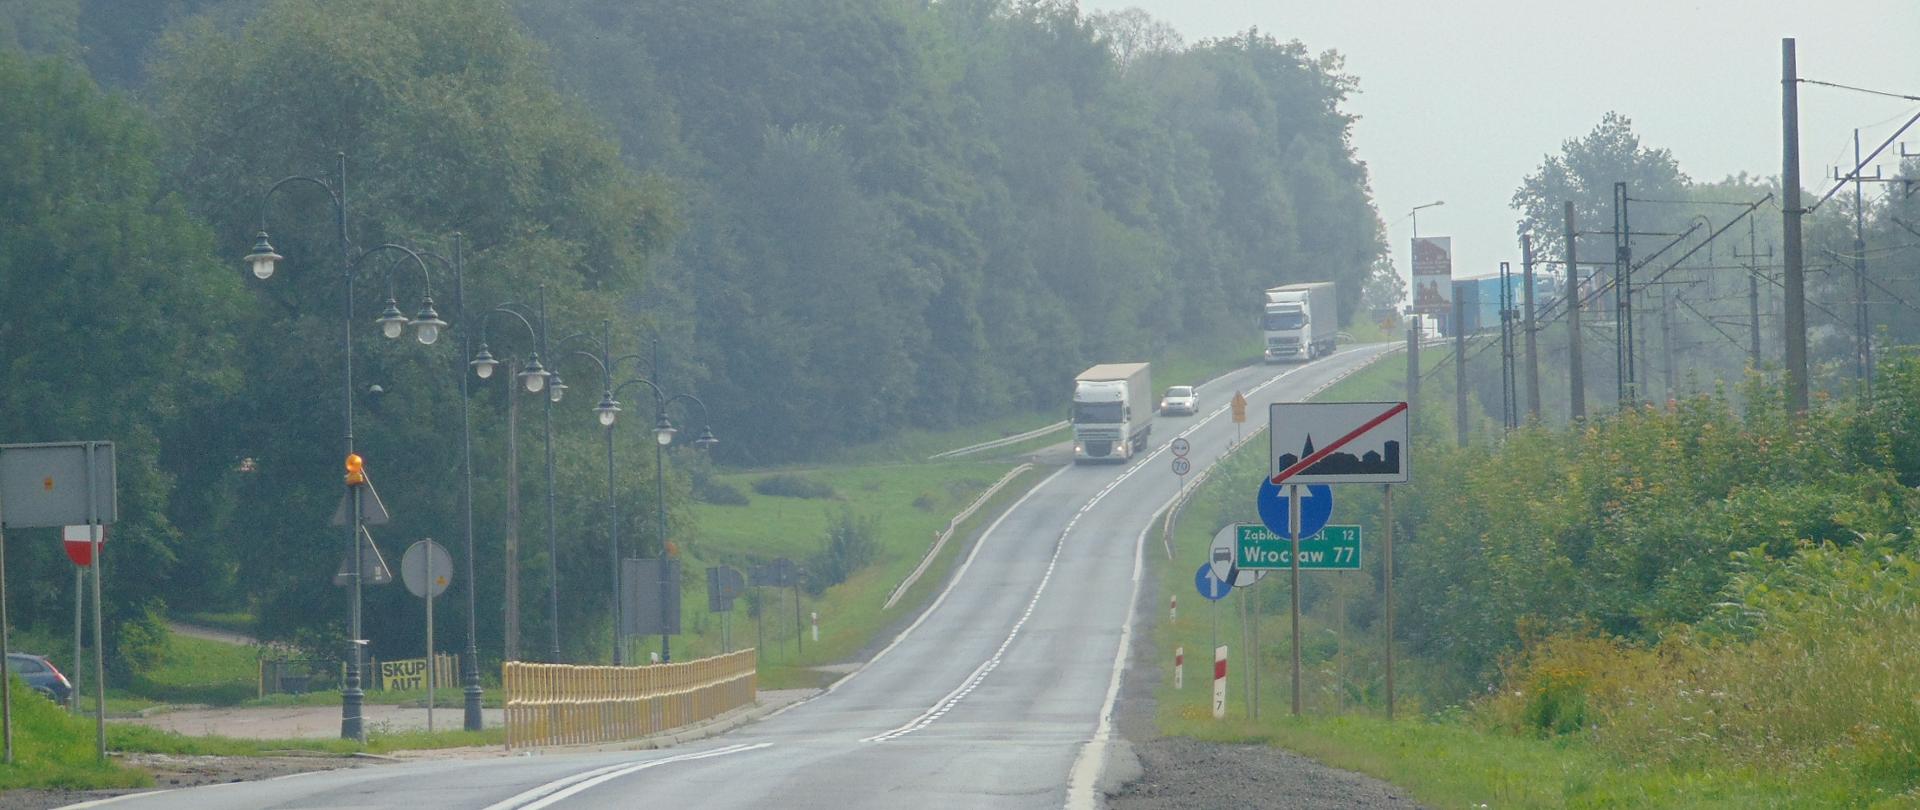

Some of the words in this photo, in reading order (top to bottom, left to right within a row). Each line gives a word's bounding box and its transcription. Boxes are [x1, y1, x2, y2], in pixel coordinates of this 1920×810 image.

[1175, 461, 1188, 471] 70
[1244, 529, 1280, 543] Ząbko
[1342, 530, 1354, 540] 12
[1244, 546, 1324, 562] Wrocaw
[1333, 547, 1354, 562] 77
[383, 661, 426, 677] SKUP
[392, 677, 421, 691] AUT
